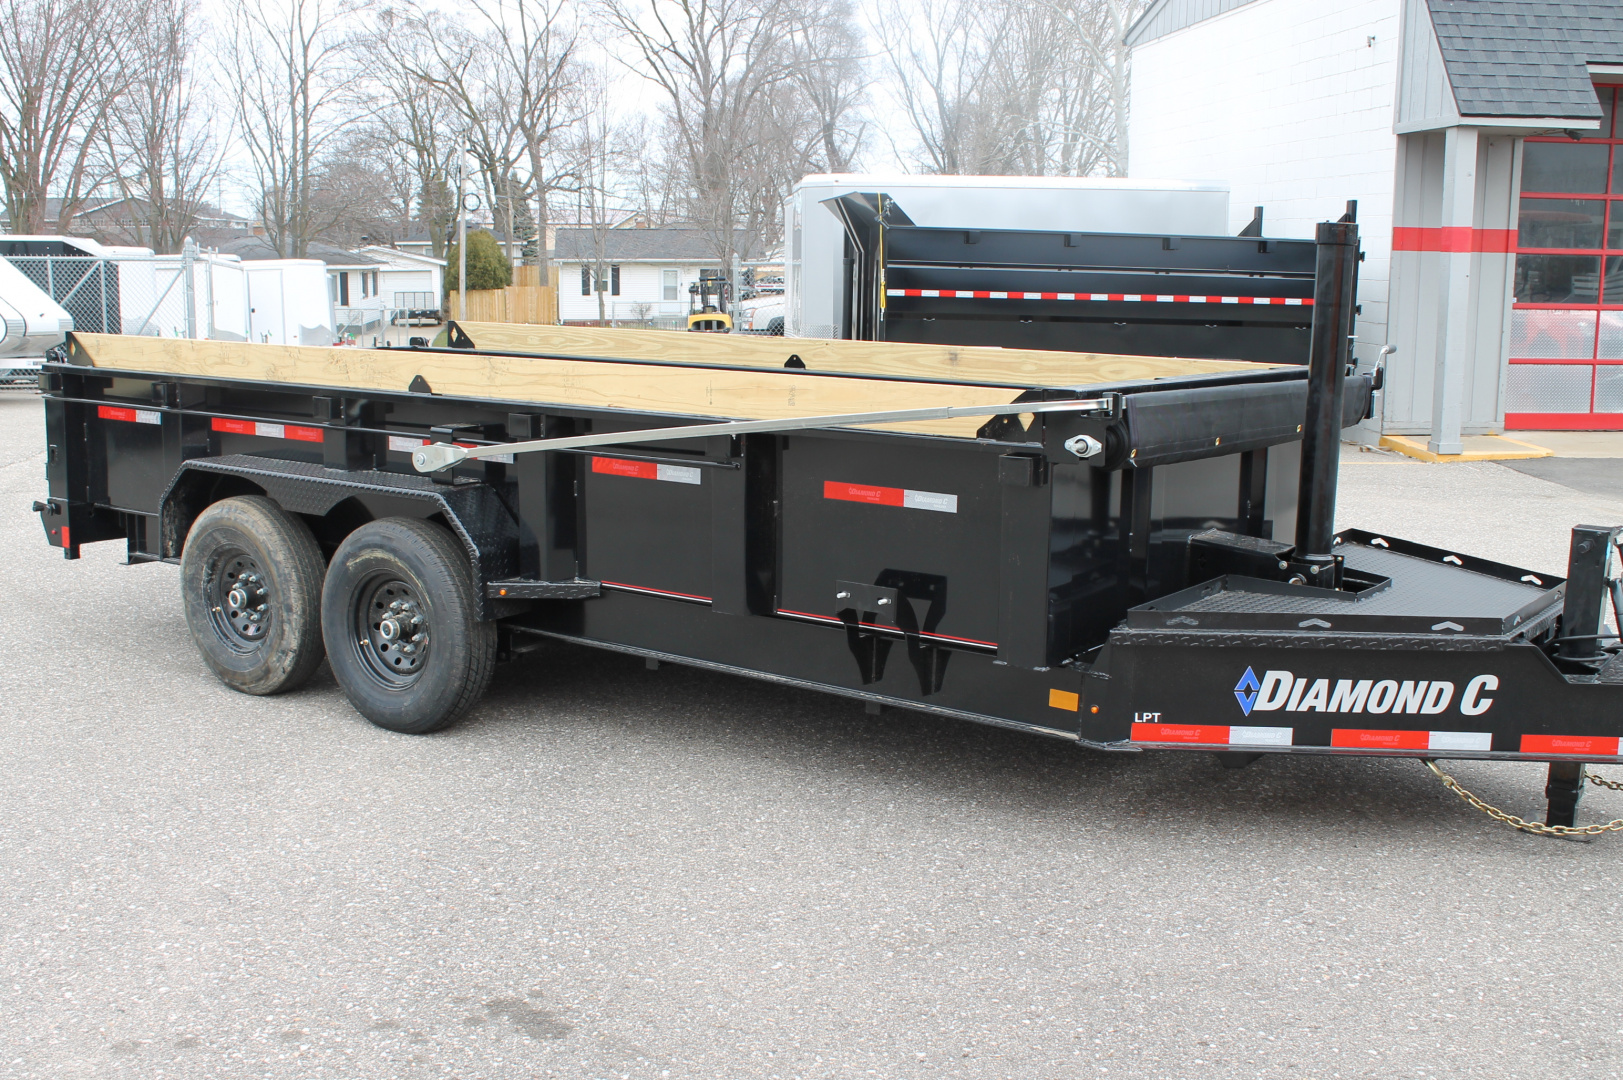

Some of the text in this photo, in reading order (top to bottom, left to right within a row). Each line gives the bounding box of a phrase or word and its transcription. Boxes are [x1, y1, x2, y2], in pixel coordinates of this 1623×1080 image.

[1252, 670, 1499, 716] DIAMOND C
[1134, 712, 1161, 723] LPT
[1394, 734, 1401, 742] C
